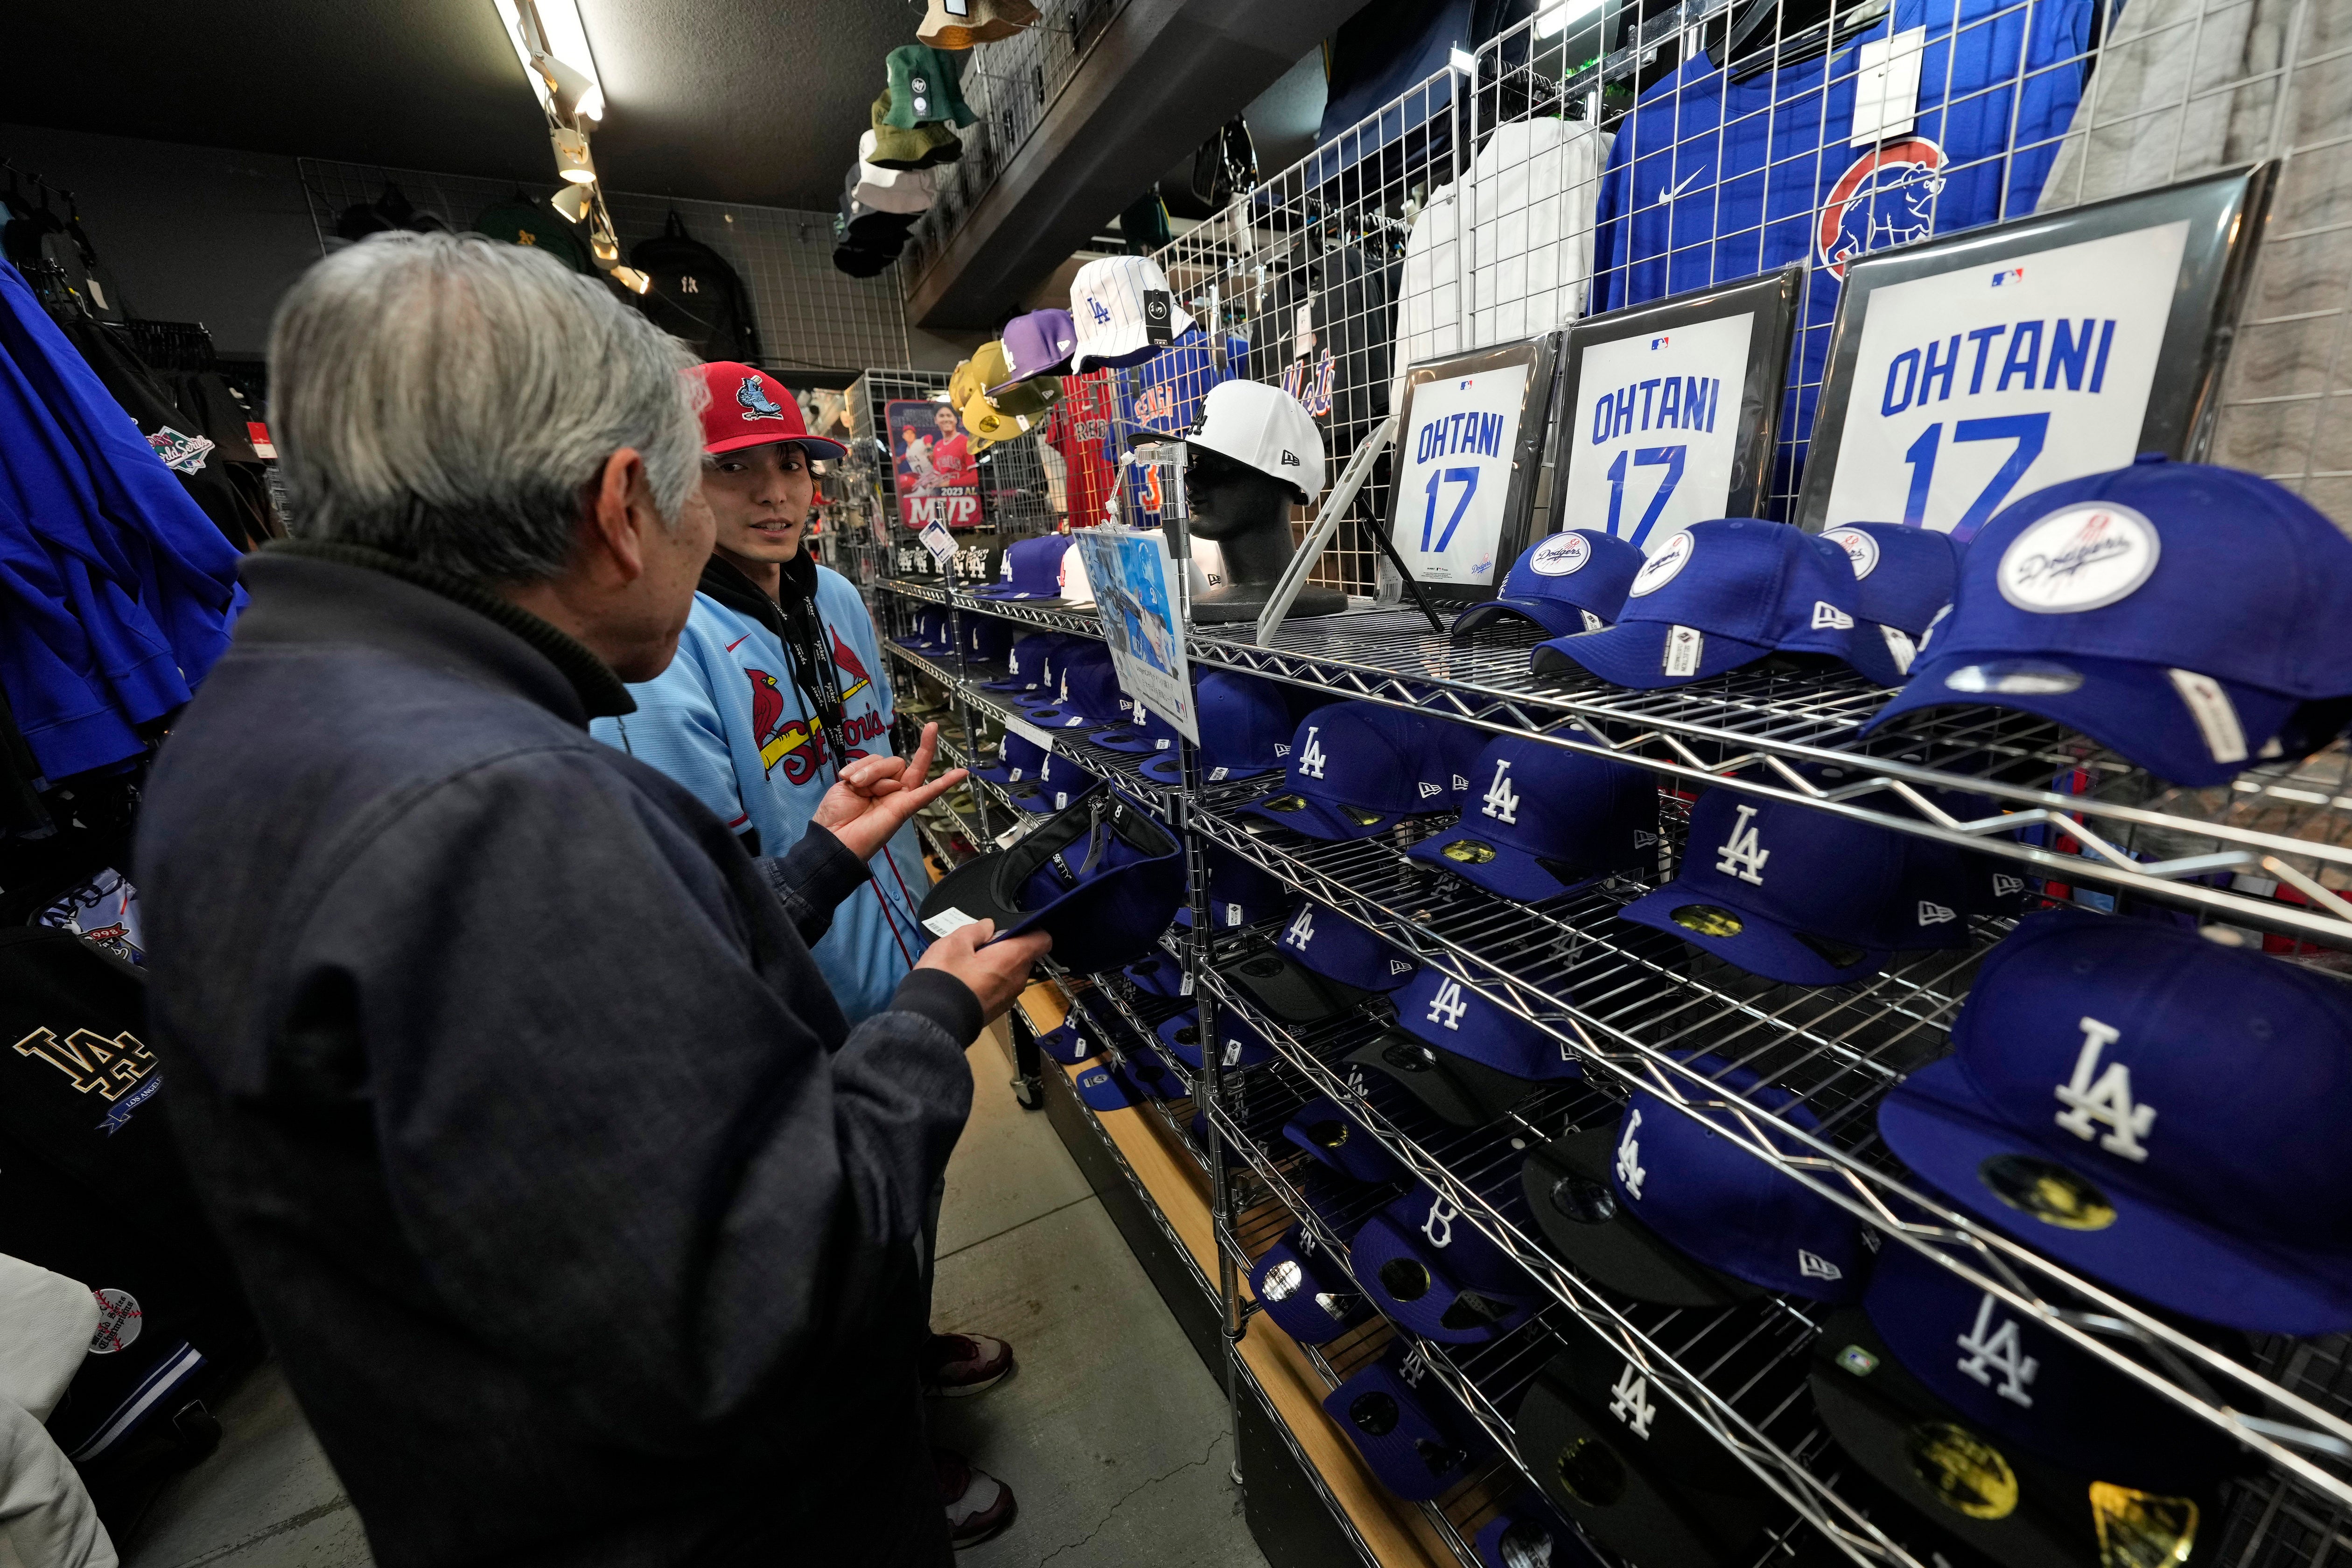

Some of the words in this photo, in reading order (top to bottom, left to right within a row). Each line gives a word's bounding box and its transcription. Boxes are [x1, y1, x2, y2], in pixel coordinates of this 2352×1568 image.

[1087, 297, 1110, 325] LA
[1282, 348, 1335, 415] Mets
[1881, 318, 2117, 418] OHTANI
[1074, 419, 1108, 443] RED
[1187, 394, 1208, 436] LA
[1592, 376, 1720, 445] OHTANI
[175, 434, 208, 457] Series
[1417, 411, 1504, 464] OHTANI
[941, 488, 964, 497] 2023
[964, 486, 978, 496] AL
[1605, 445, 1687, 548] 17
[1902, 411, 2051, 544] 17
[1420, 467, 1480, 553] 17
[1471, 560, 1492, 574] Dodgers
[1536, 547, 1582, 562] Dodgers
[805, 596, 815, 617] socket
[1078, 537, 1115, 641] OHTANI
[814, 640, 826, 662] socket
[825, 682, 837, 704] socket
[834, 724, 844, 746] socket
[1299, 727, 1326, 779] LA
[1115, 805, 1122, 818] 8
[1482, 759, 1519, 826] LA
[1053, 853, 1072, 879] 59FIFTY
[1716, 804, 1770, 886] LA
[91, 929, 119, 939] 998
[1286, 902, 1315, 952] LA
[1427, 976, 1467, 1031] LA
[13, 1026, 160, 1102] LA
[2055, 1017, 2156, 1162] LA
[126, 1096, 141, 1107] LOS
[1616, 1109, 1646, 1201] LA
[1299, 1213, 1316, 1258] LA
[1421, 1183, 1458, 1248] B
[1399, 1349, 1416, 1389] LA
[1957, 1293, 2039, 1409] LA
[1609, 1363, 1656, 1441] LA
